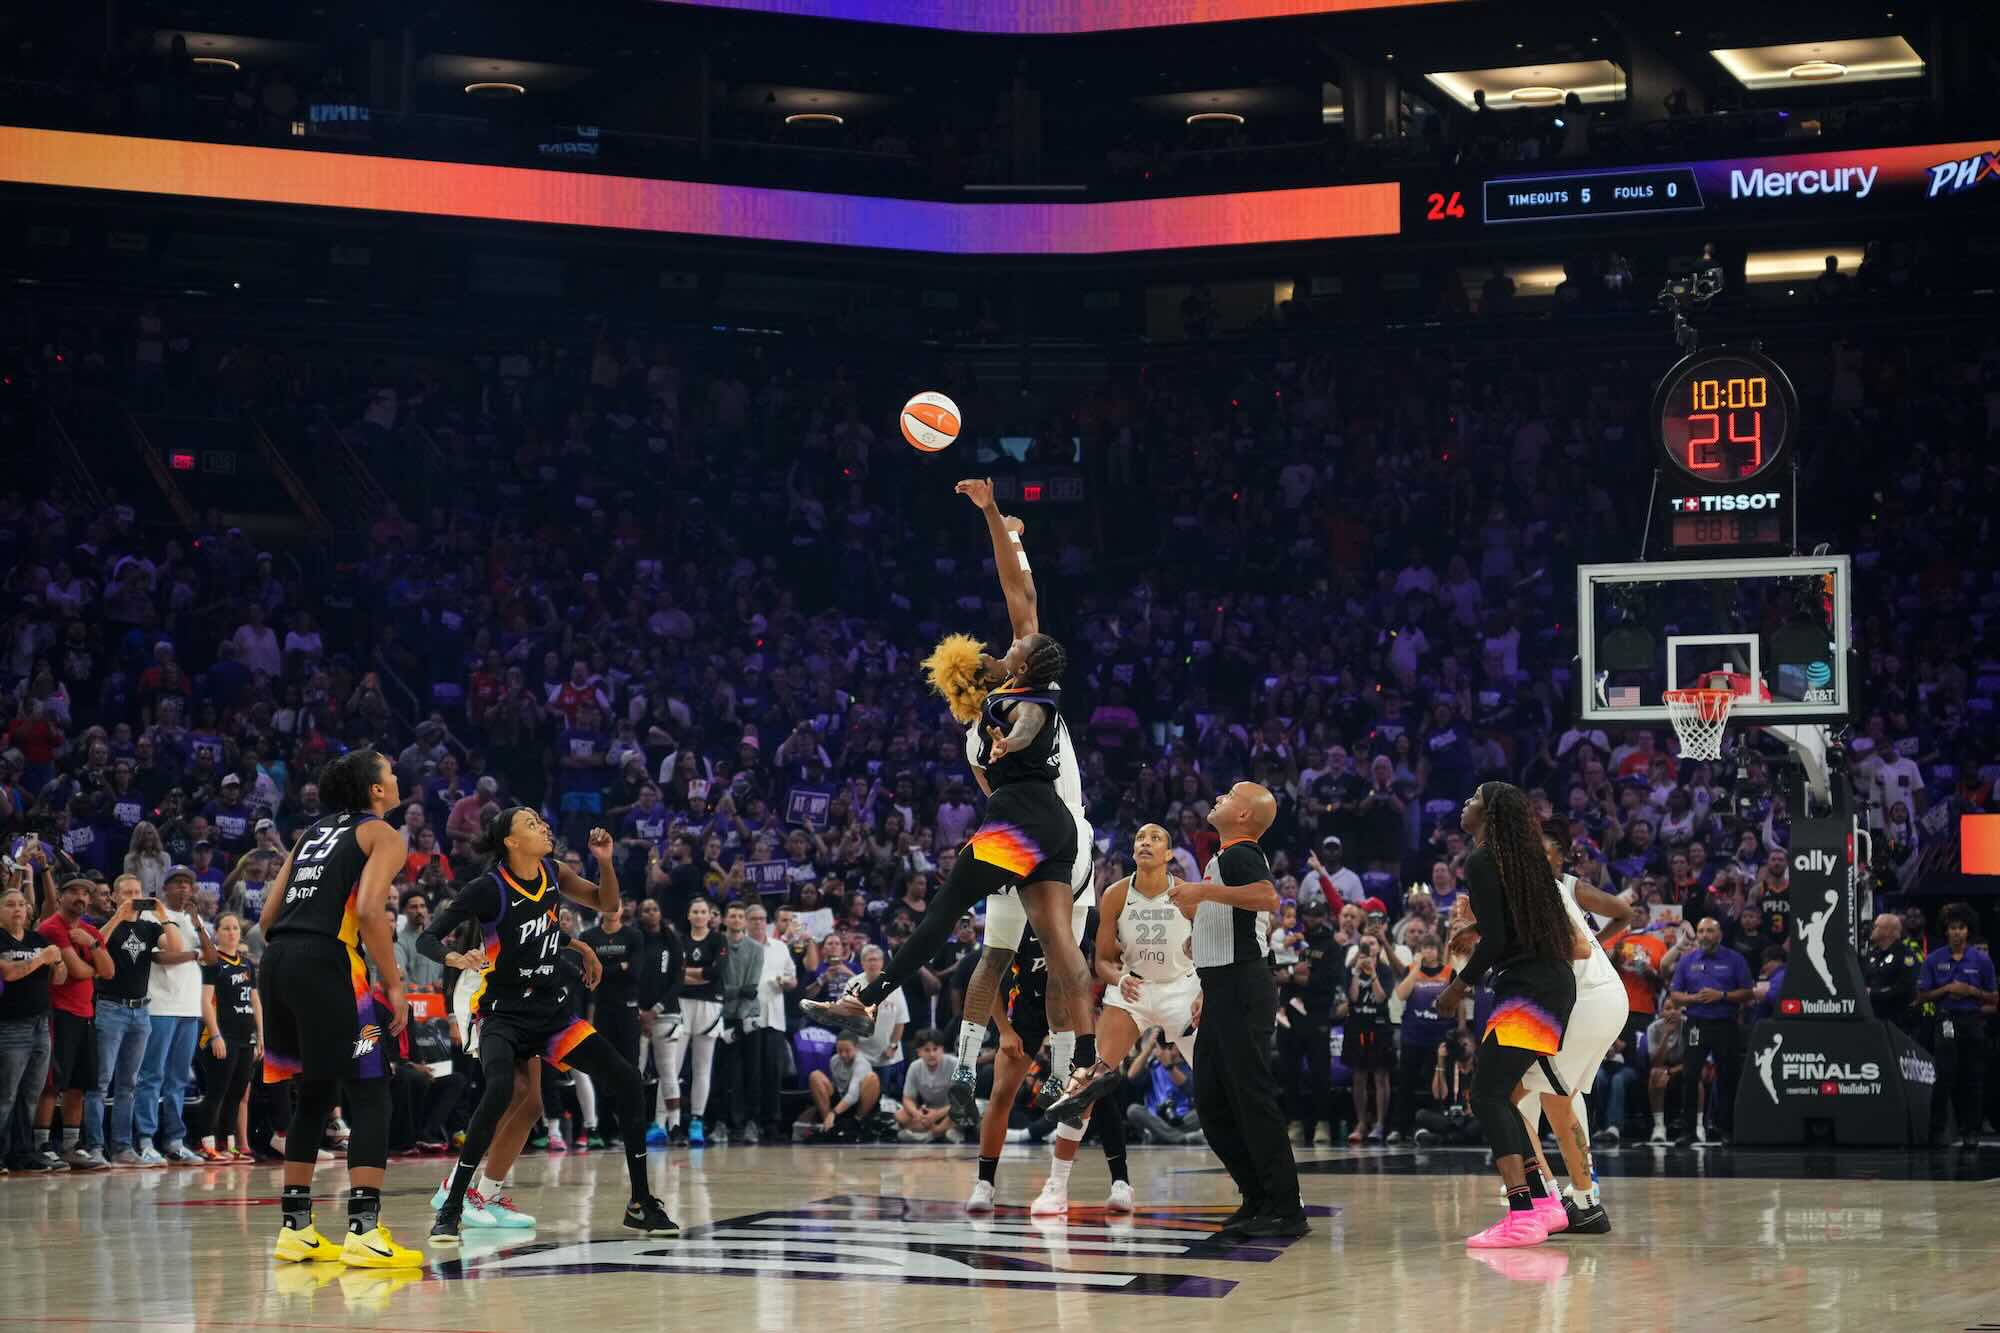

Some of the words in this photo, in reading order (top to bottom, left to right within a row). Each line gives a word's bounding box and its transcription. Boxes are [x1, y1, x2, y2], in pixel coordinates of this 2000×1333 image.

[1614, 185, 1654, 199] FOULS
[1666, 182, 1678, 198] 0
[1731, 164, 1879, 199] Mercury
[1426, 191, 1466, 221] 24
[1508, 191, 1569, 206] TIMEOUTS
[1580, 188, 1592, 204] 5
[1692, 377, 1767, 411] 10:00
[1687, 411, 1761, 470] 24
[1701, 493, 1781, 511] TISSOT
[1803, 688, 1835, 702] AT&T
[296, 827, 352, 861] 25
[1794, 849, 1838, 876] ally
[519, 903, 559, 945] PHX
[1135, 923, 1168, 945] 22
[539, 930, 560, 959] 14
[1136, 948, 1166, 966] ring
[1801, 999, 1841, 1015] YouTube
[1841, 999, 1856, 1014] TV
[1782, 1053, 1827, 1063] WNBA
[1782, 1063, 1880, 1081] FINALS
[1838, 1082, 1870, 1096] YouTube
[1870, 1083, 1882, 1095] TV
